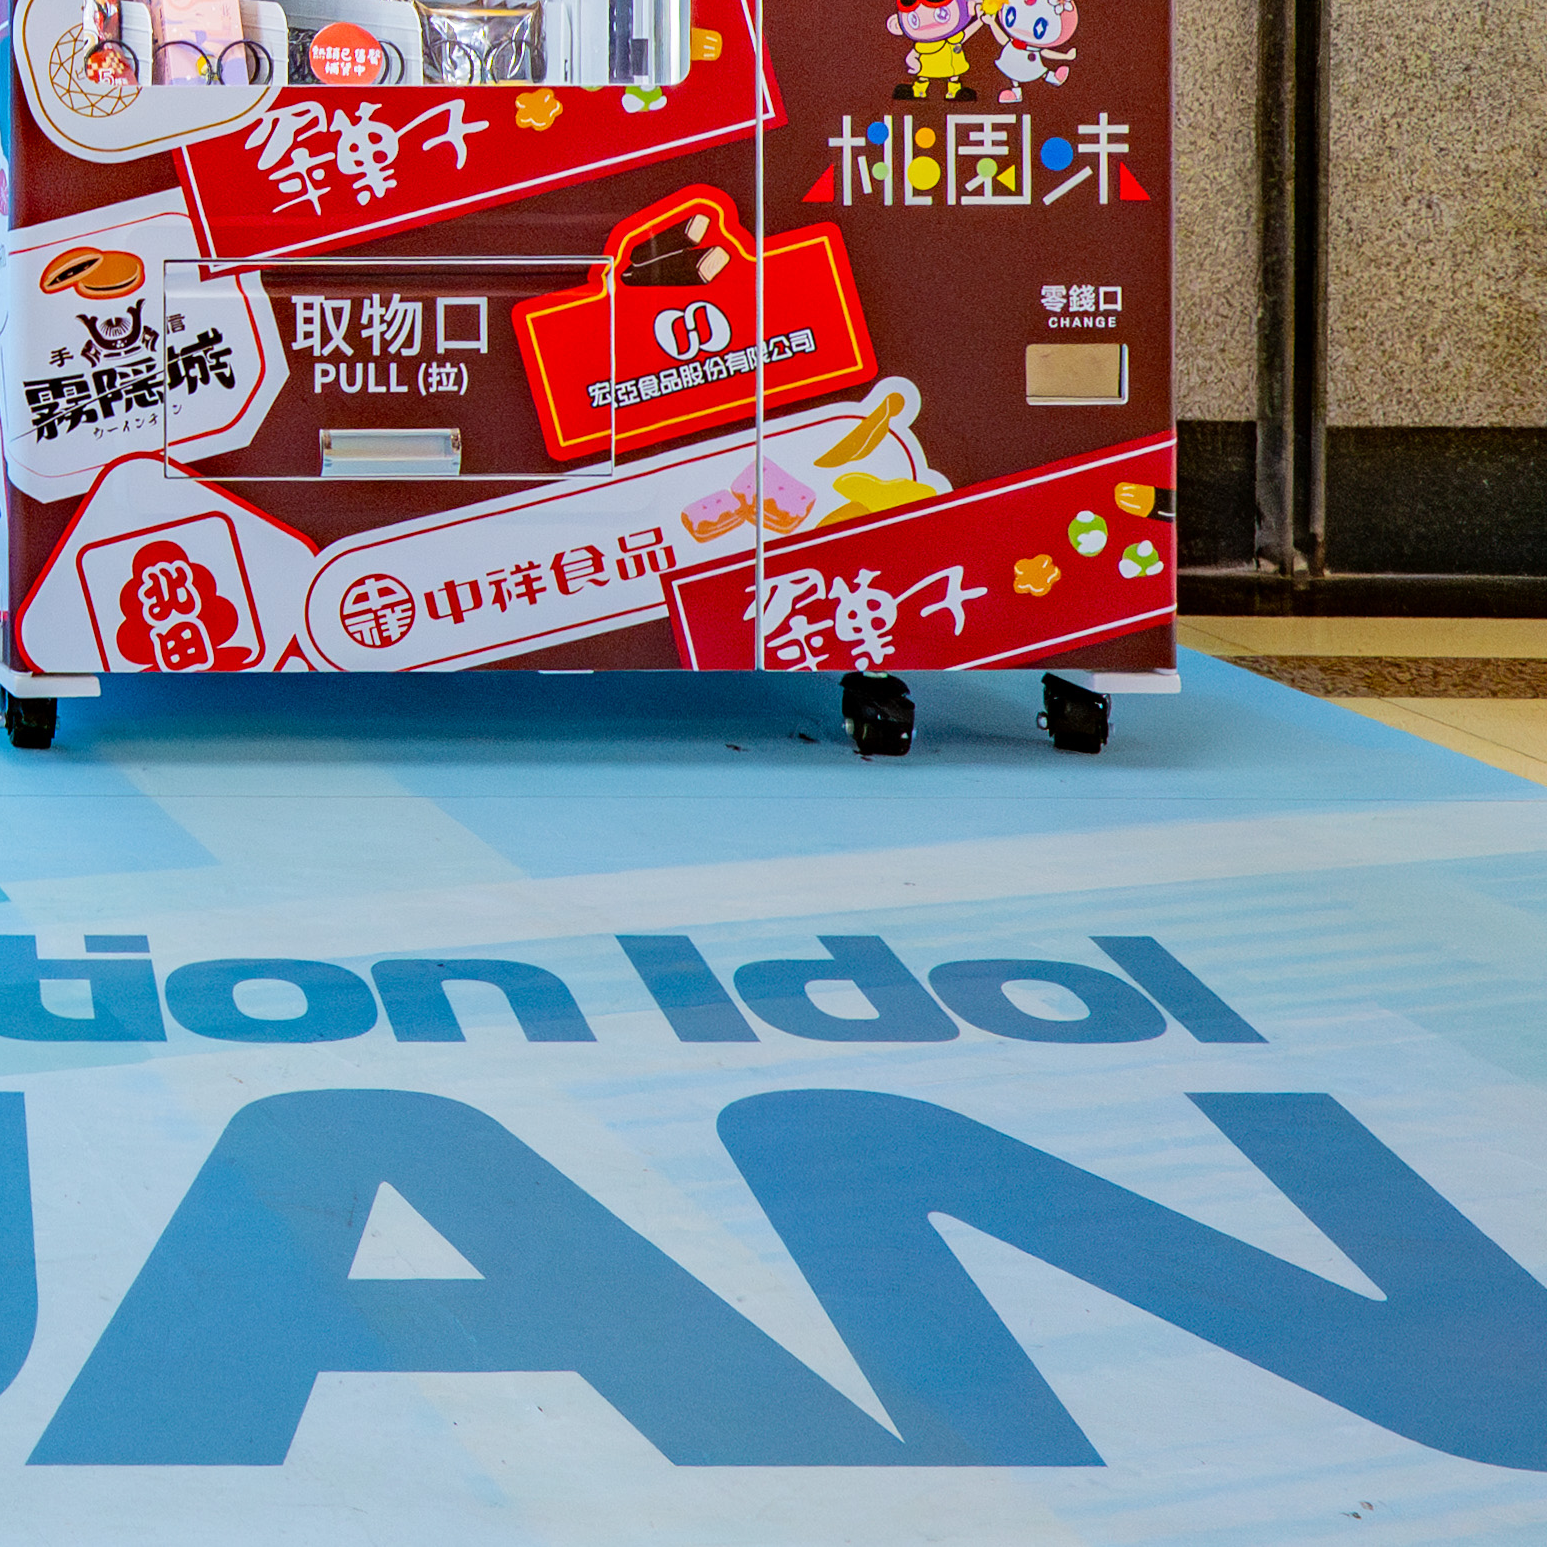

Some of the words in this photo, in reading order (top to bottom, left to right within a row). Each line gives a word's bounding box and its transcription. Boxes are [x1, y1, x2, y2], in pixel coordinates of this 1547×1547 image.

[244, 98, 490, 216] 翠菓子
[828, 113, 1131, 206] 桃園味
[291, 293, 489, 354] 取物口
[1040, 284, 1124, 313] 零錢口
[1048, 316, 1118, 329] CHANGE
[48, 346, 74, 368] 手
[313, 361, 408, 394] PULL
[416, 361, 470, 397] (拉)
[587, 327, 815, 411] 宏亞食品股份有限公司
[138, 557, 217, 672] 北田
[424, 529, 676, 625] 中祥食品
[615, 934, 1269, 1045] Idol
